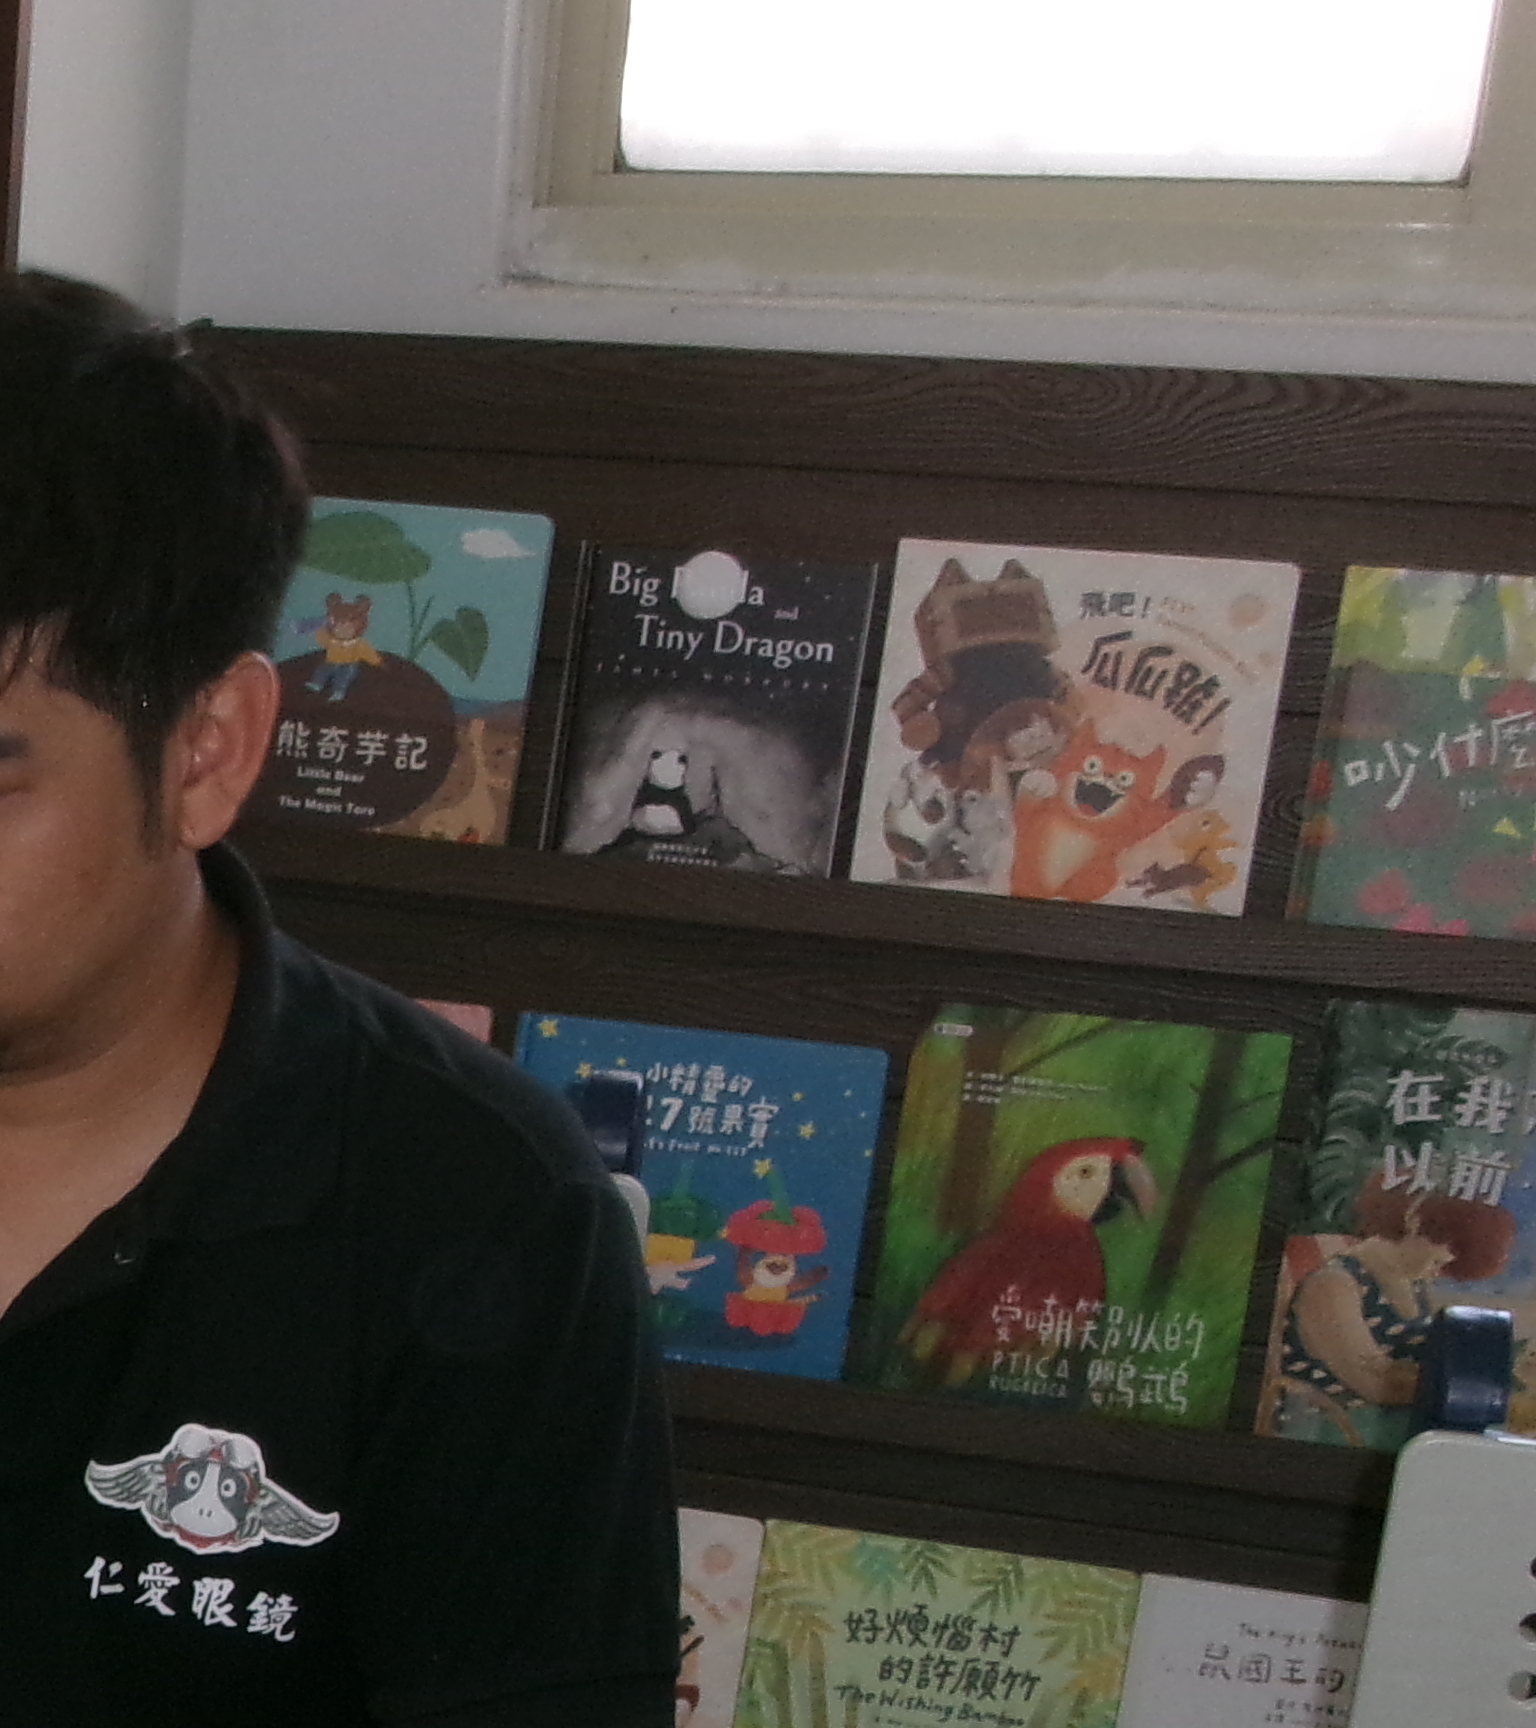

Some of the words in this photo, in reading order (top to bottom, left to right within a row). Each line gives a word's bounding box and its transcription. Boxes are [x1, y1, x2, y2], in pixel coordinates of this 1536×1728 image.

[609, 561, 661, 607] Big
[635, 614, 704, 661] Tiny
[714, 620, 834, 669] Dragon
[83, 1556, 299, 1642] 仁愛眼鏡
